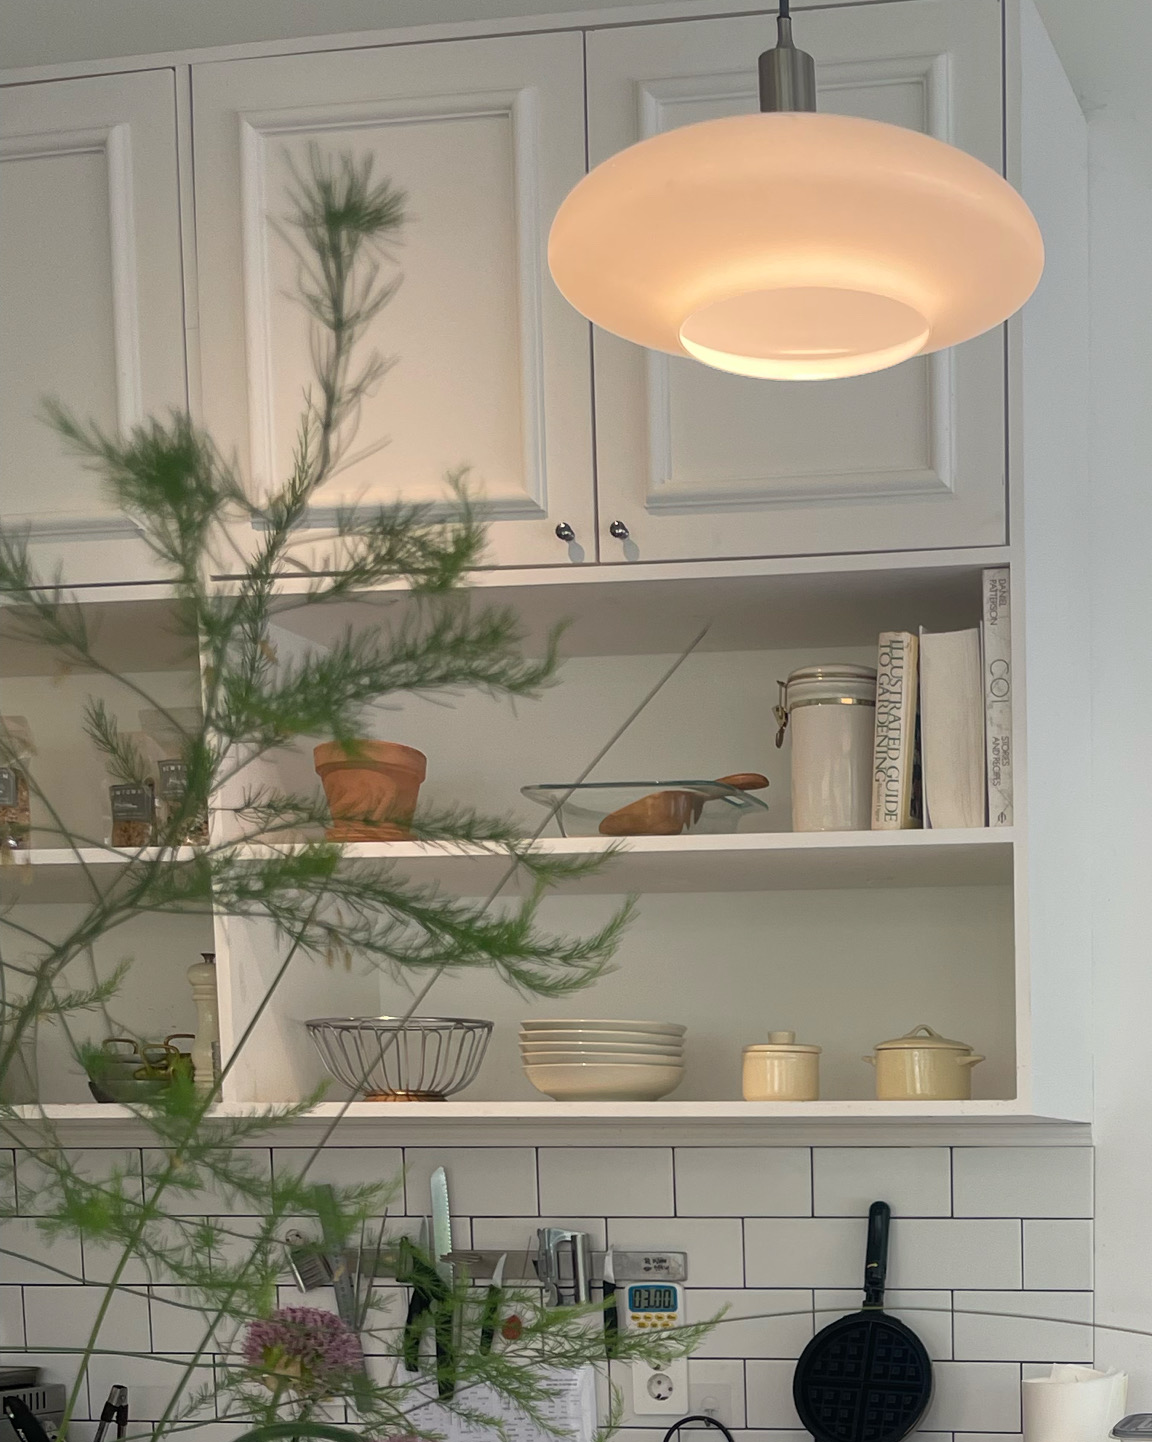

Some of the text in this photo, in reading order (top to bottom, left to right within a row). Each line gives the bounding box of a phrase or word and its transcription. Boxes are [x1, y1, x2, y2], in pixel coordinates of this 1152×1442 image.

[875, 644, 892, 783] TO GARDENING
[884, 766, 900, 823] GUIDE
